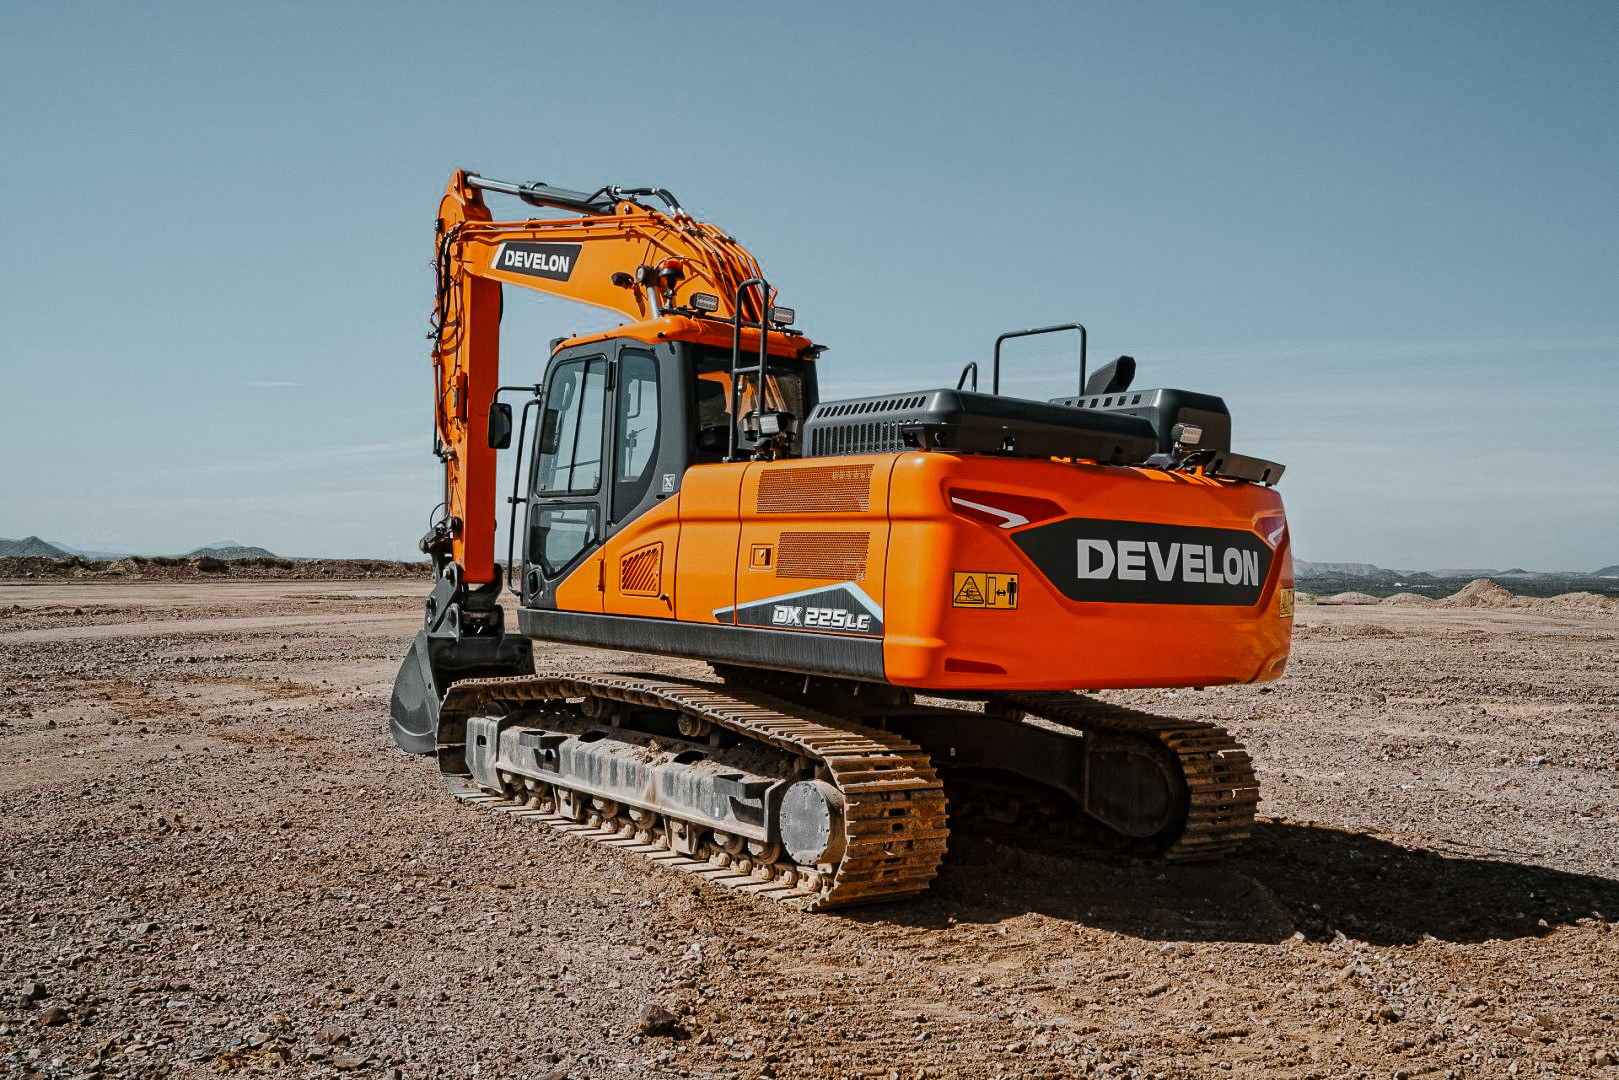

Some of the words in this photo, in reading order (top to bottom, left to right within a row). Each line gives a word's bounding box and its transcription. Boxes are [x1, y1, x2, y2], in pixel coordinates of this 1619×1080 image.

[504, 249, 570, 273] DEVELON
[1077, 538, 1259, 586] DEVELON
[772, 605, 802, 626] DX
[804, 607, 871, 632] 225LC
